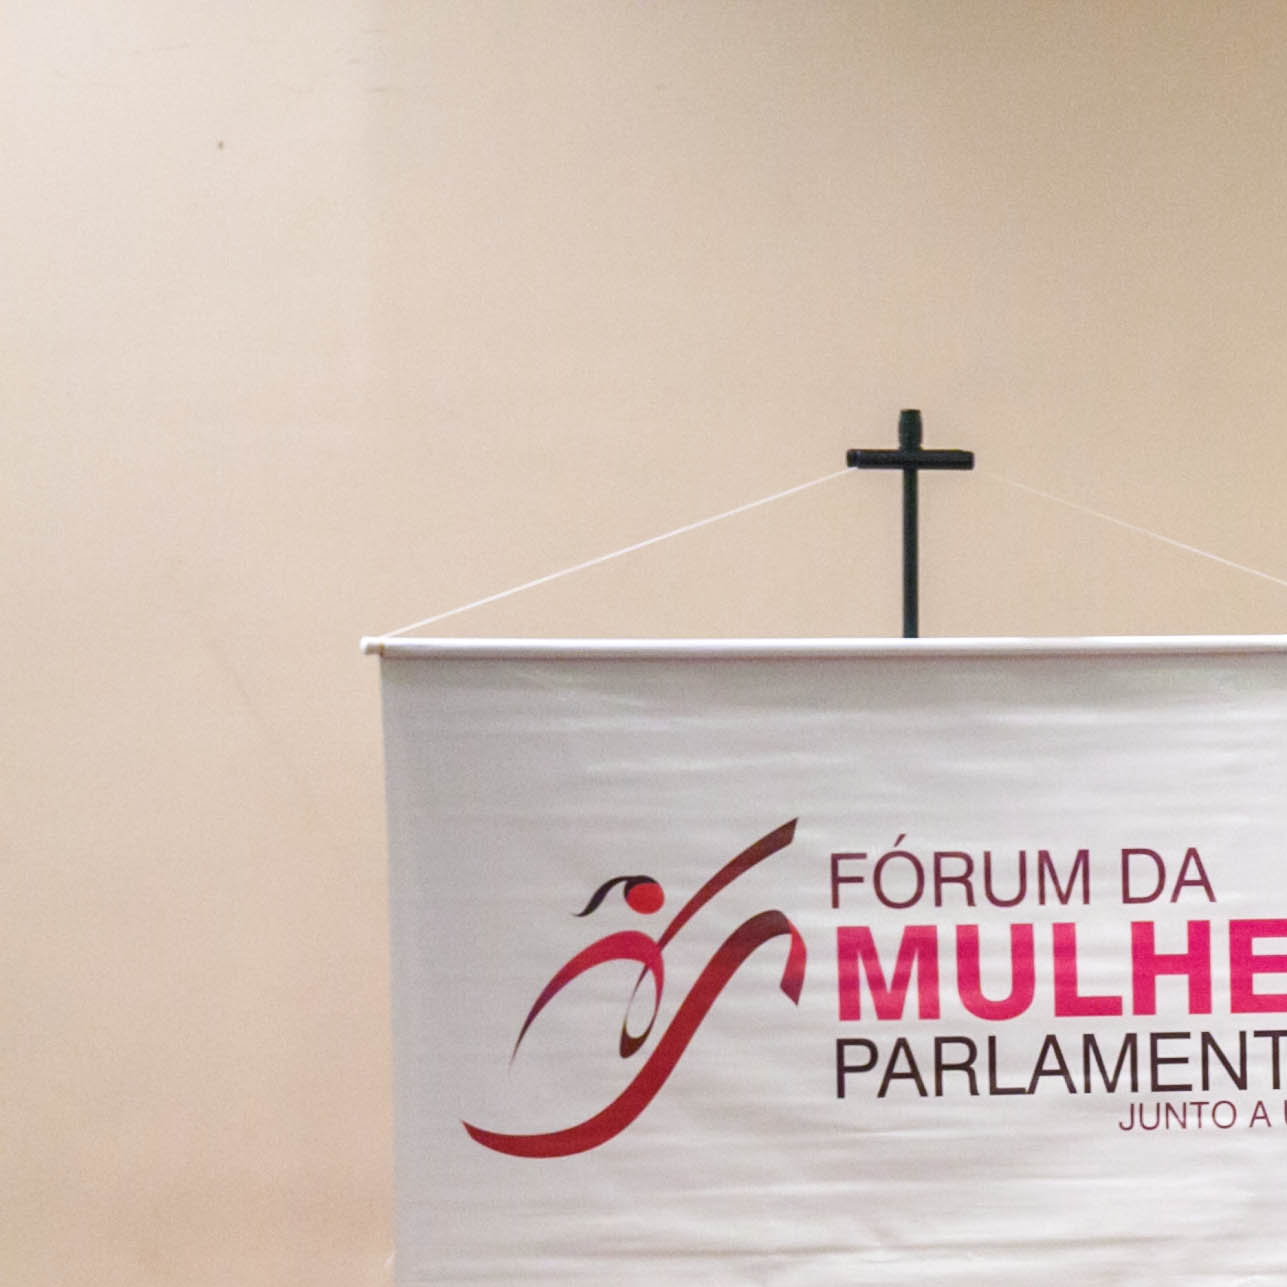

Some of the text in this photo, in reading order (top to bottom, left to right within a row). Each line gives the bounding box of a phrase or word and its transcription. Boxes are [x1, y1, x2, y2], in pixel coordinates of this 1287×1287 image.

[829, 834, 1217, 910] FÓRUM DA
[1119, 1101, 1238, 1132] JUNTO
[1250, 1101, 1274, 1129] A
